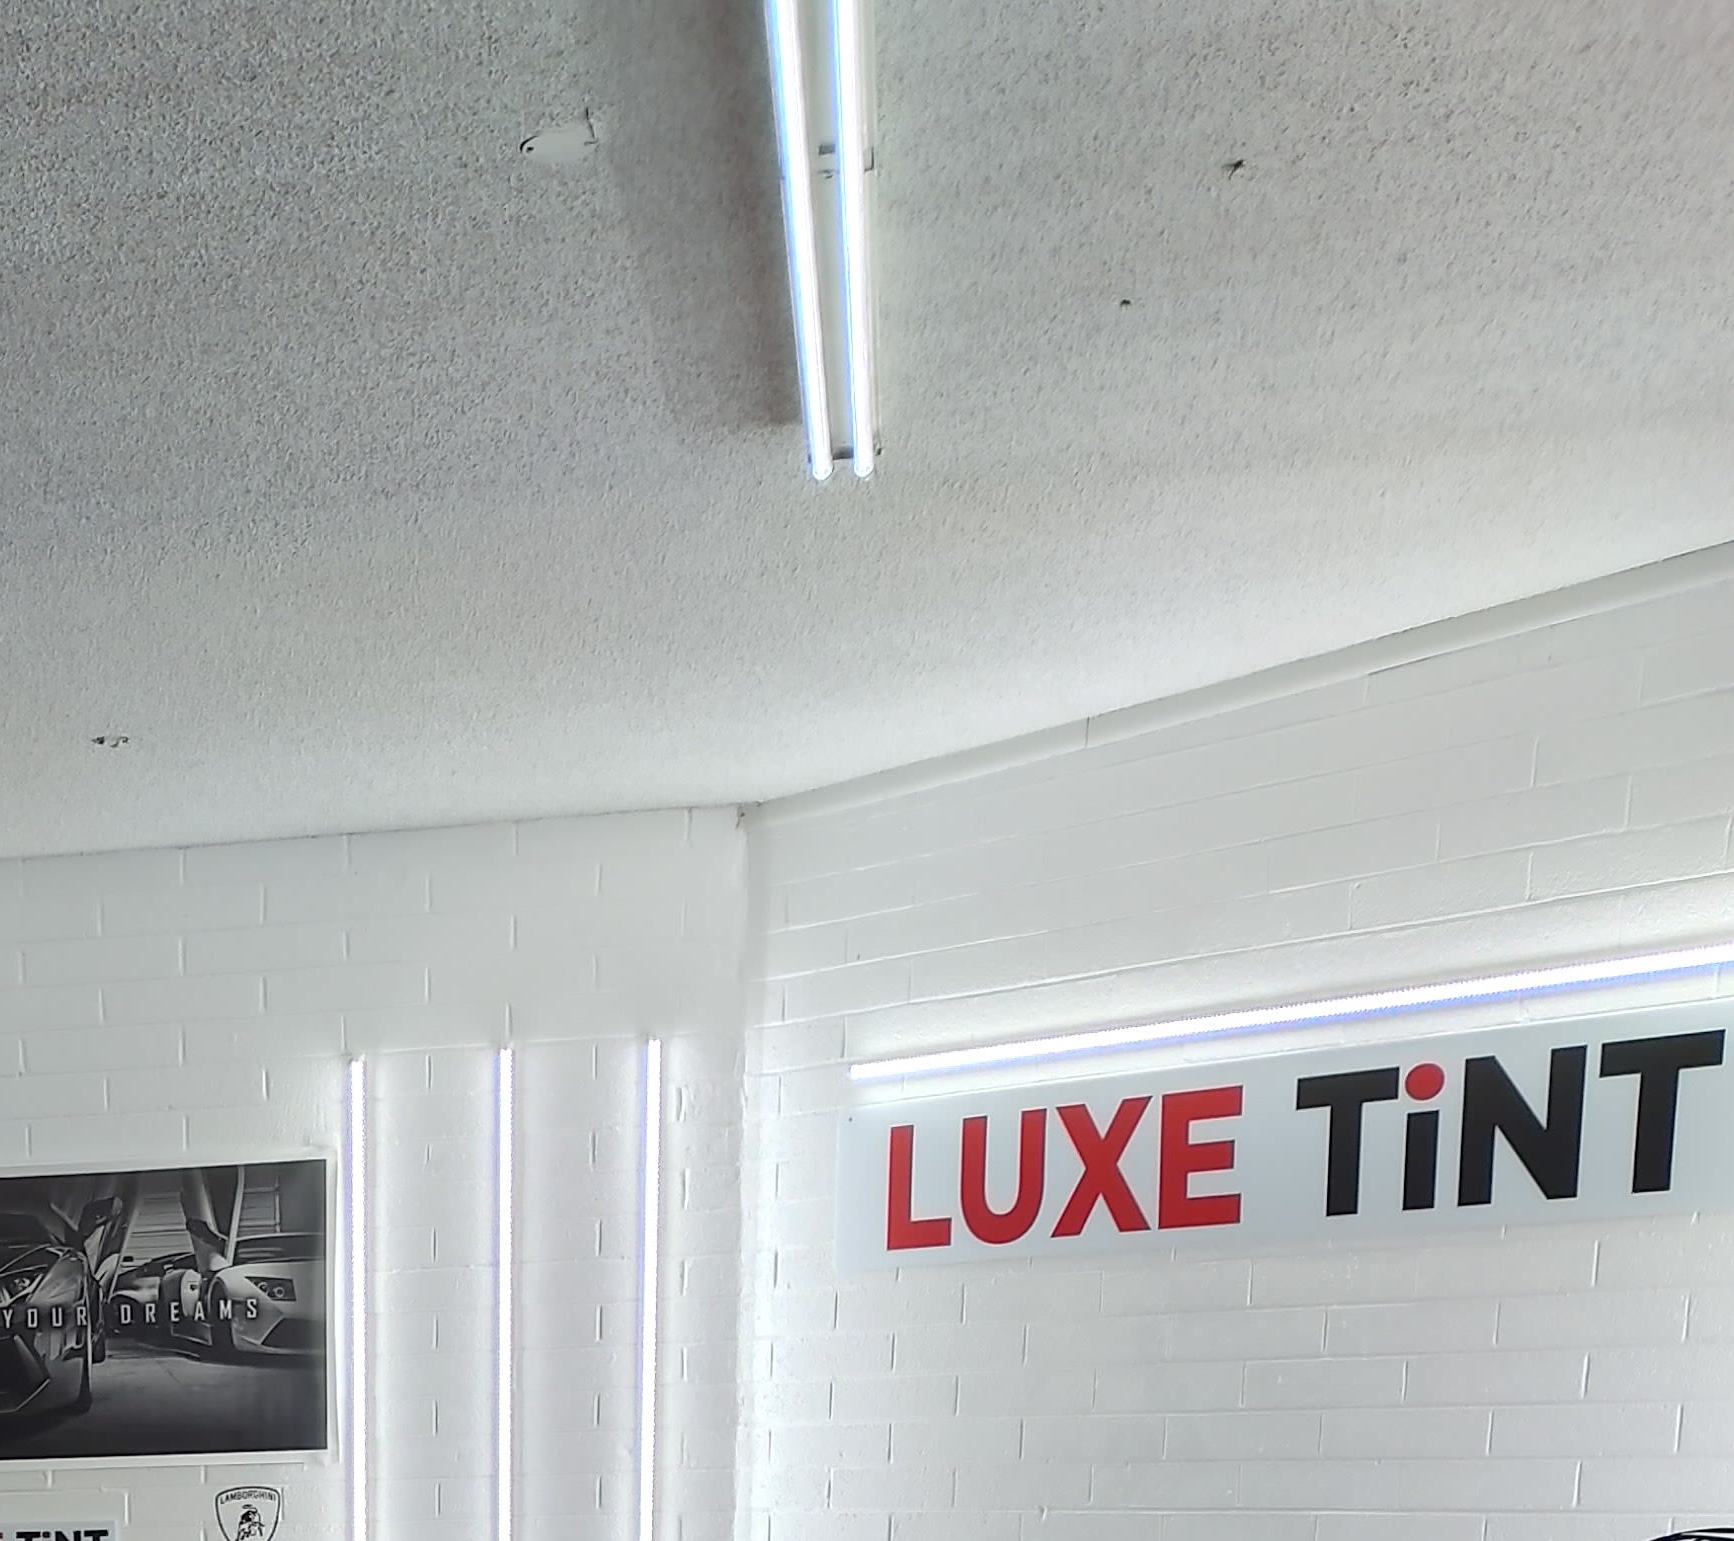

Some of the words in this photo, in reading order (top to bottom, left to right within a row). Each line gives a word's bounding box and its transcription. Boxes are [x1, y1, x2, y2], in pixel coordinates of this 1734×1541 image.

[886, 1085, 1244, 1251] LUXE
[1296, 1029, 1725, 1217] TiNT
[2, 1306, 87, 1329] YOUR
[120, 1299, 258, 1325] DREAMS
[220, 1490, 277, 1504] LAMBORGHINI
